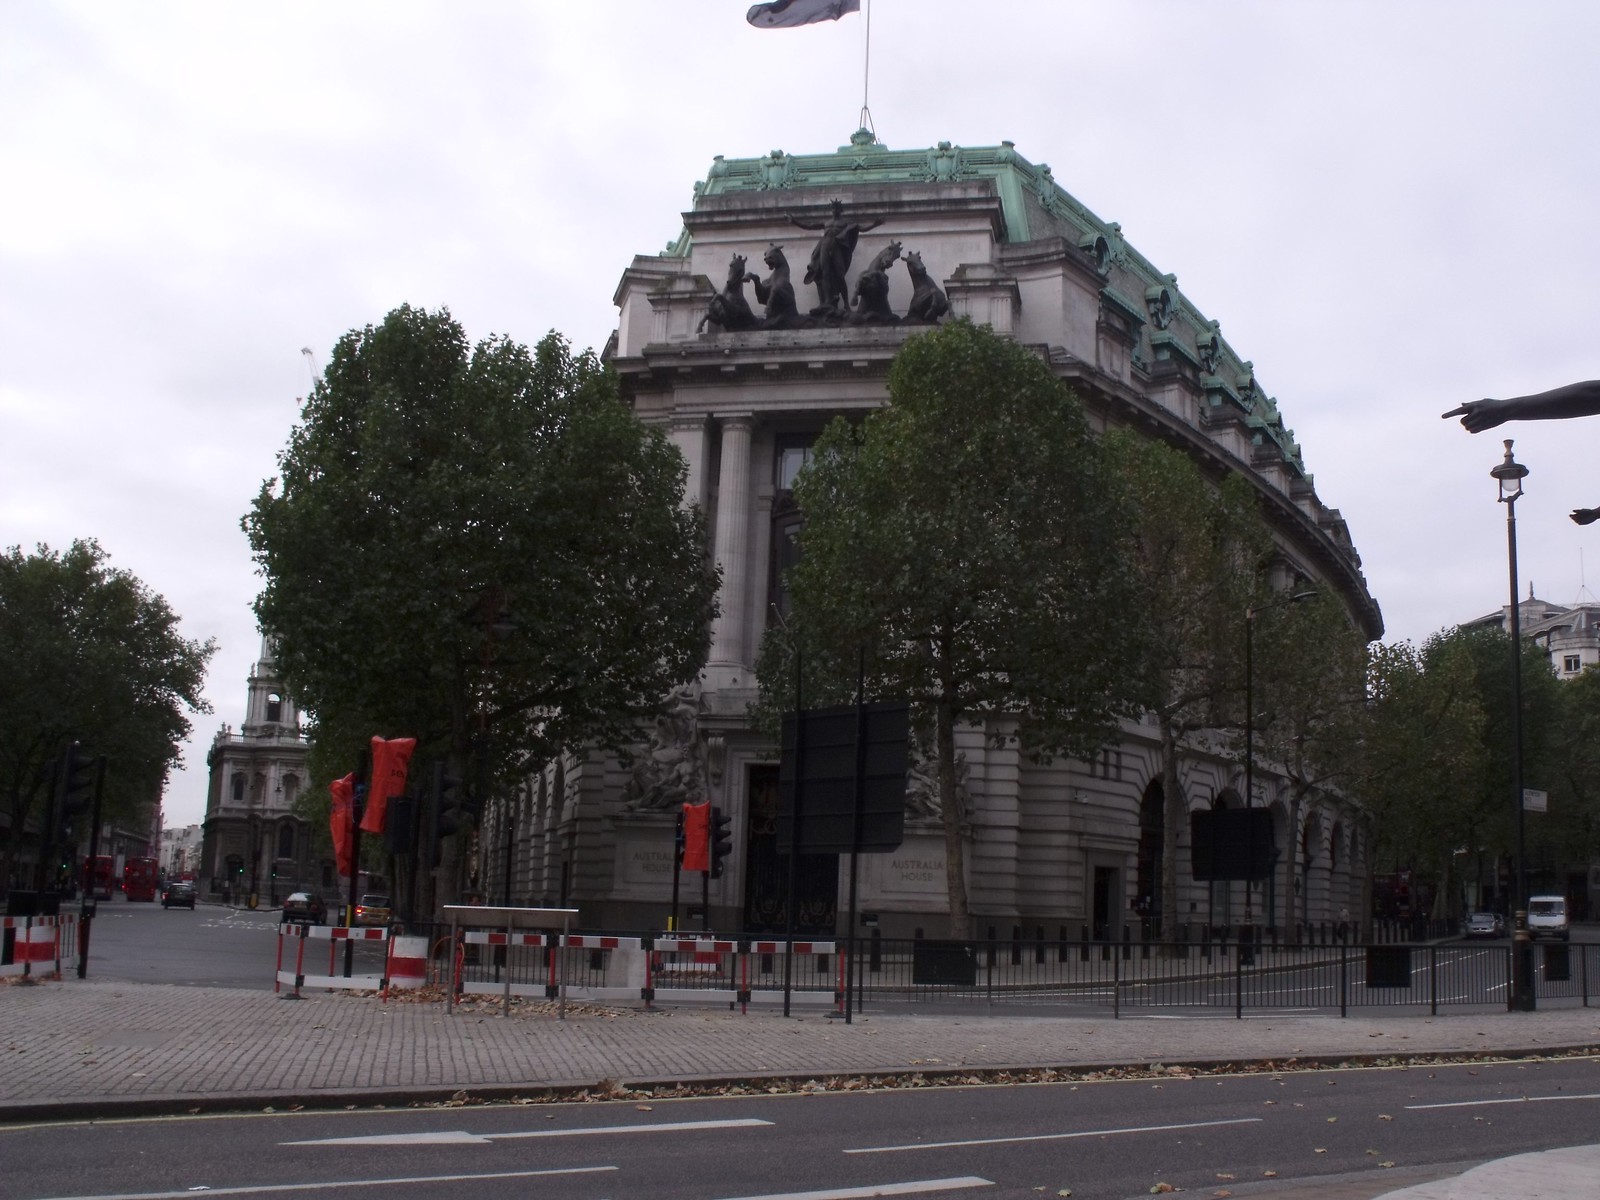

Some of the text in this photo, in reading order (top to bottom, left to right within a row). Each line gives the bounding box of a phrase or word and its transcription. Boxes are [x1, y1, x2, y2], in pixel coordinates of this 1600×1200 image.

[632, 851, 675, 861] AUSTRAL
[642, 863, 672, 873] HOUSE
[891, 859, 944, 871] AUSTRALIA
[901, 872, 933, 882] HOUSE
